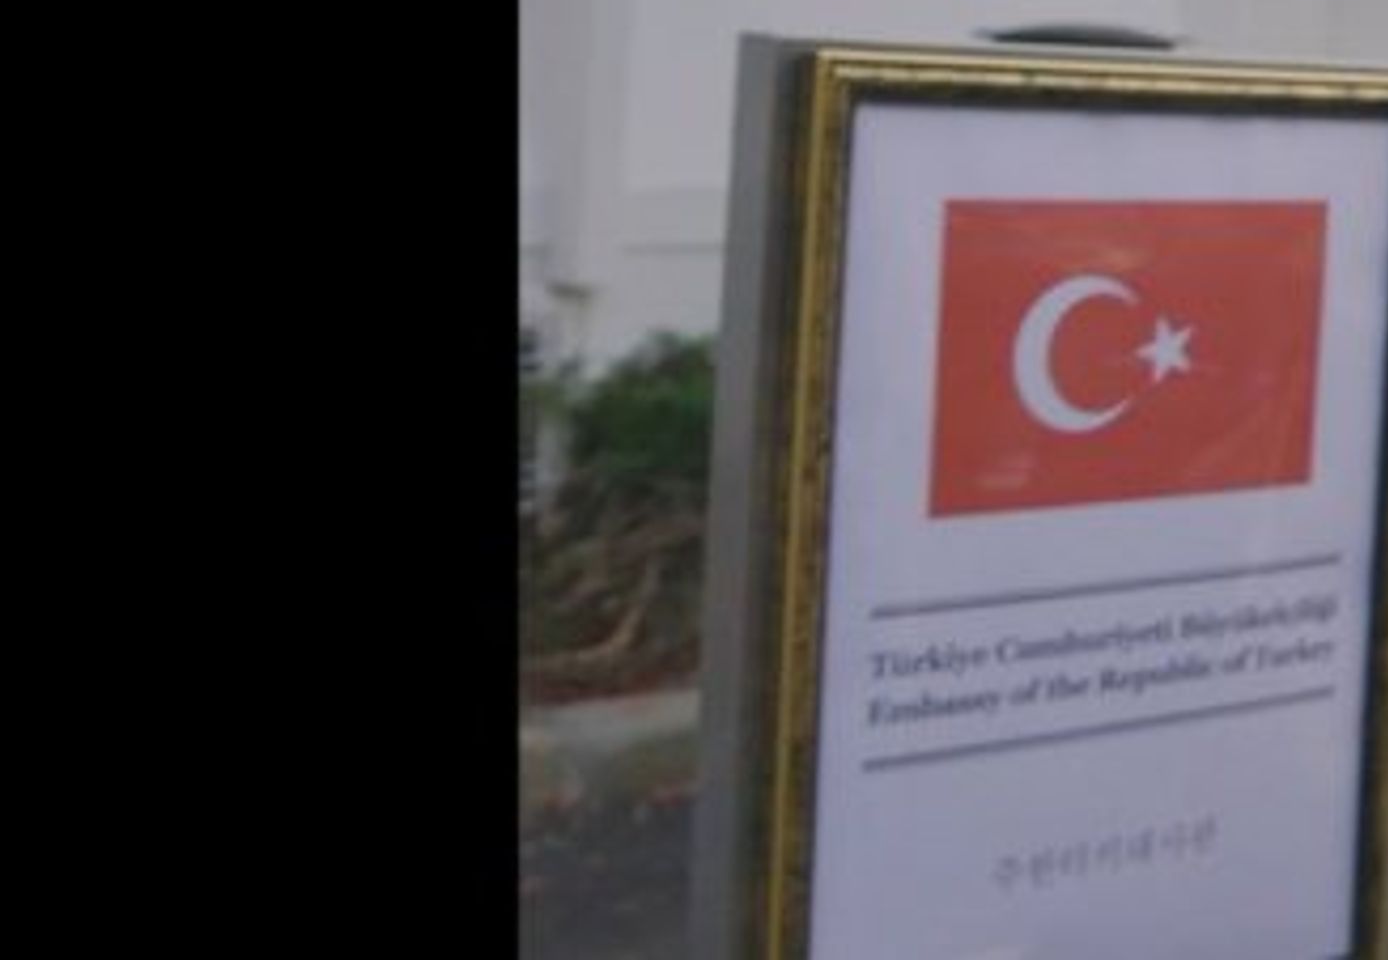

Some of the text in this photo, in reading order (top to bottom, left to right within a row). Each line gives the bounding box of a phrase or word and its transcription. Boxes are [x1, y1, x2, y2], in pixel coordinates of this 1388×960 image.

[867, 690, 1001, 727] Embassy
[1009, 677, 1042, 706] of
[1046, 673, 1091, 701] the
[1098, 652, 1212, 695] Republic
[1221, 644, 1254, 674] of
